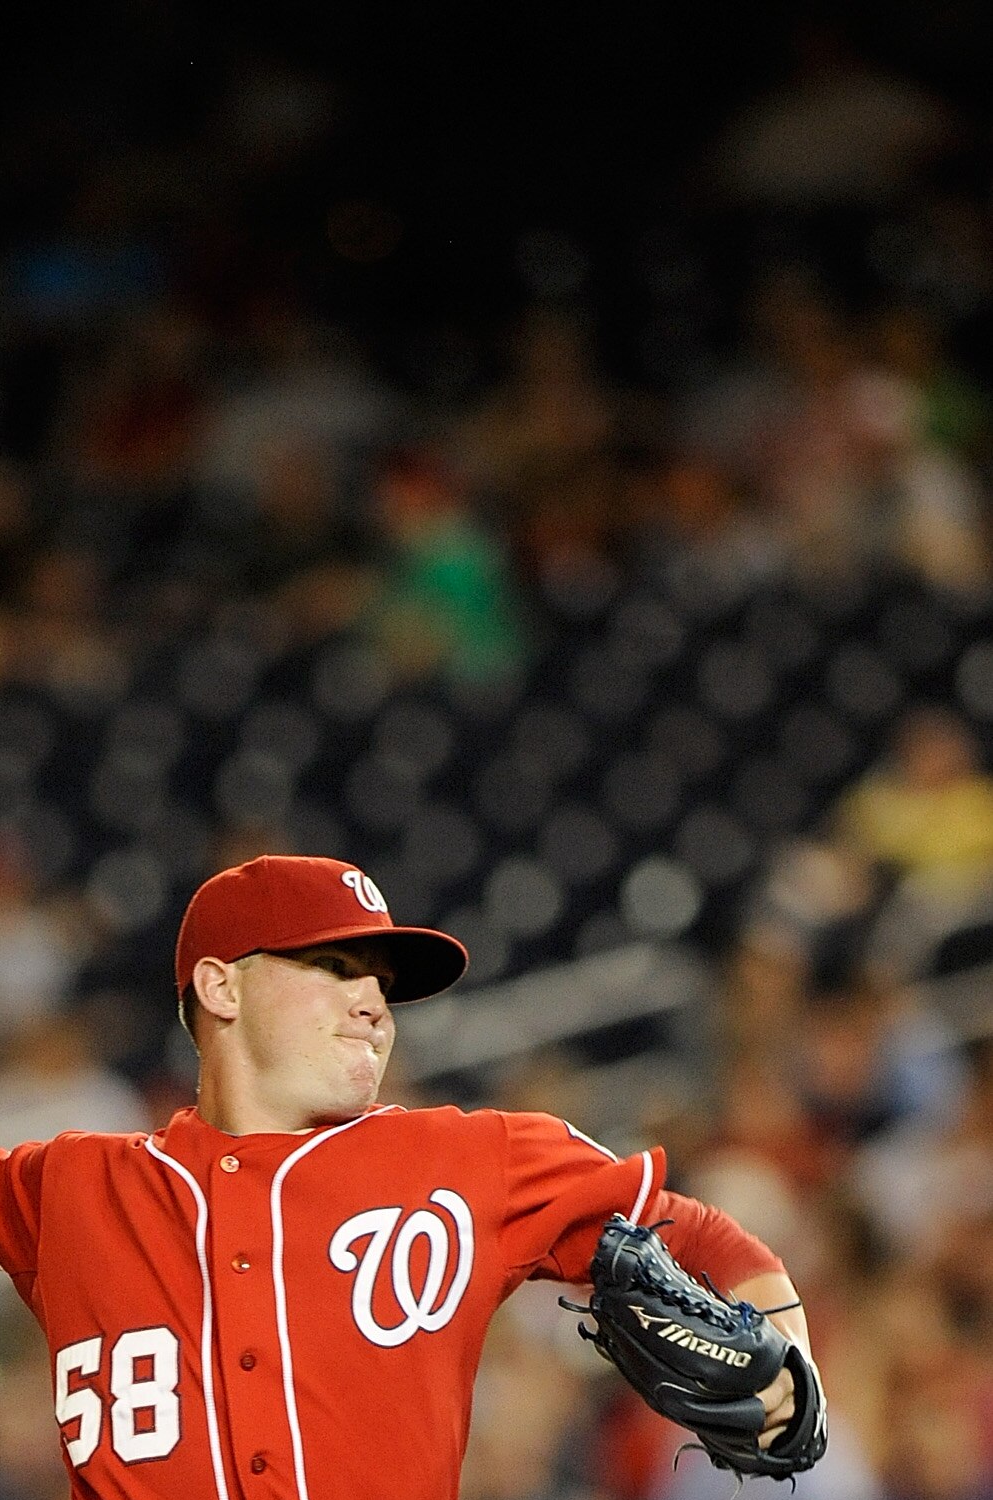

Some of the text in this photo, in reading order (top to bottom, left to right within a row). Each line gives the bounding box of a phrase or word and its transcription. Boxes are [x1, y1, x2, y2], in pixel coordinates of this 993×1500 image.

[341, 870, 389, 914] W
[328, 1187, 475, 1349] W
[54, 1323, 182, 1469] 58
